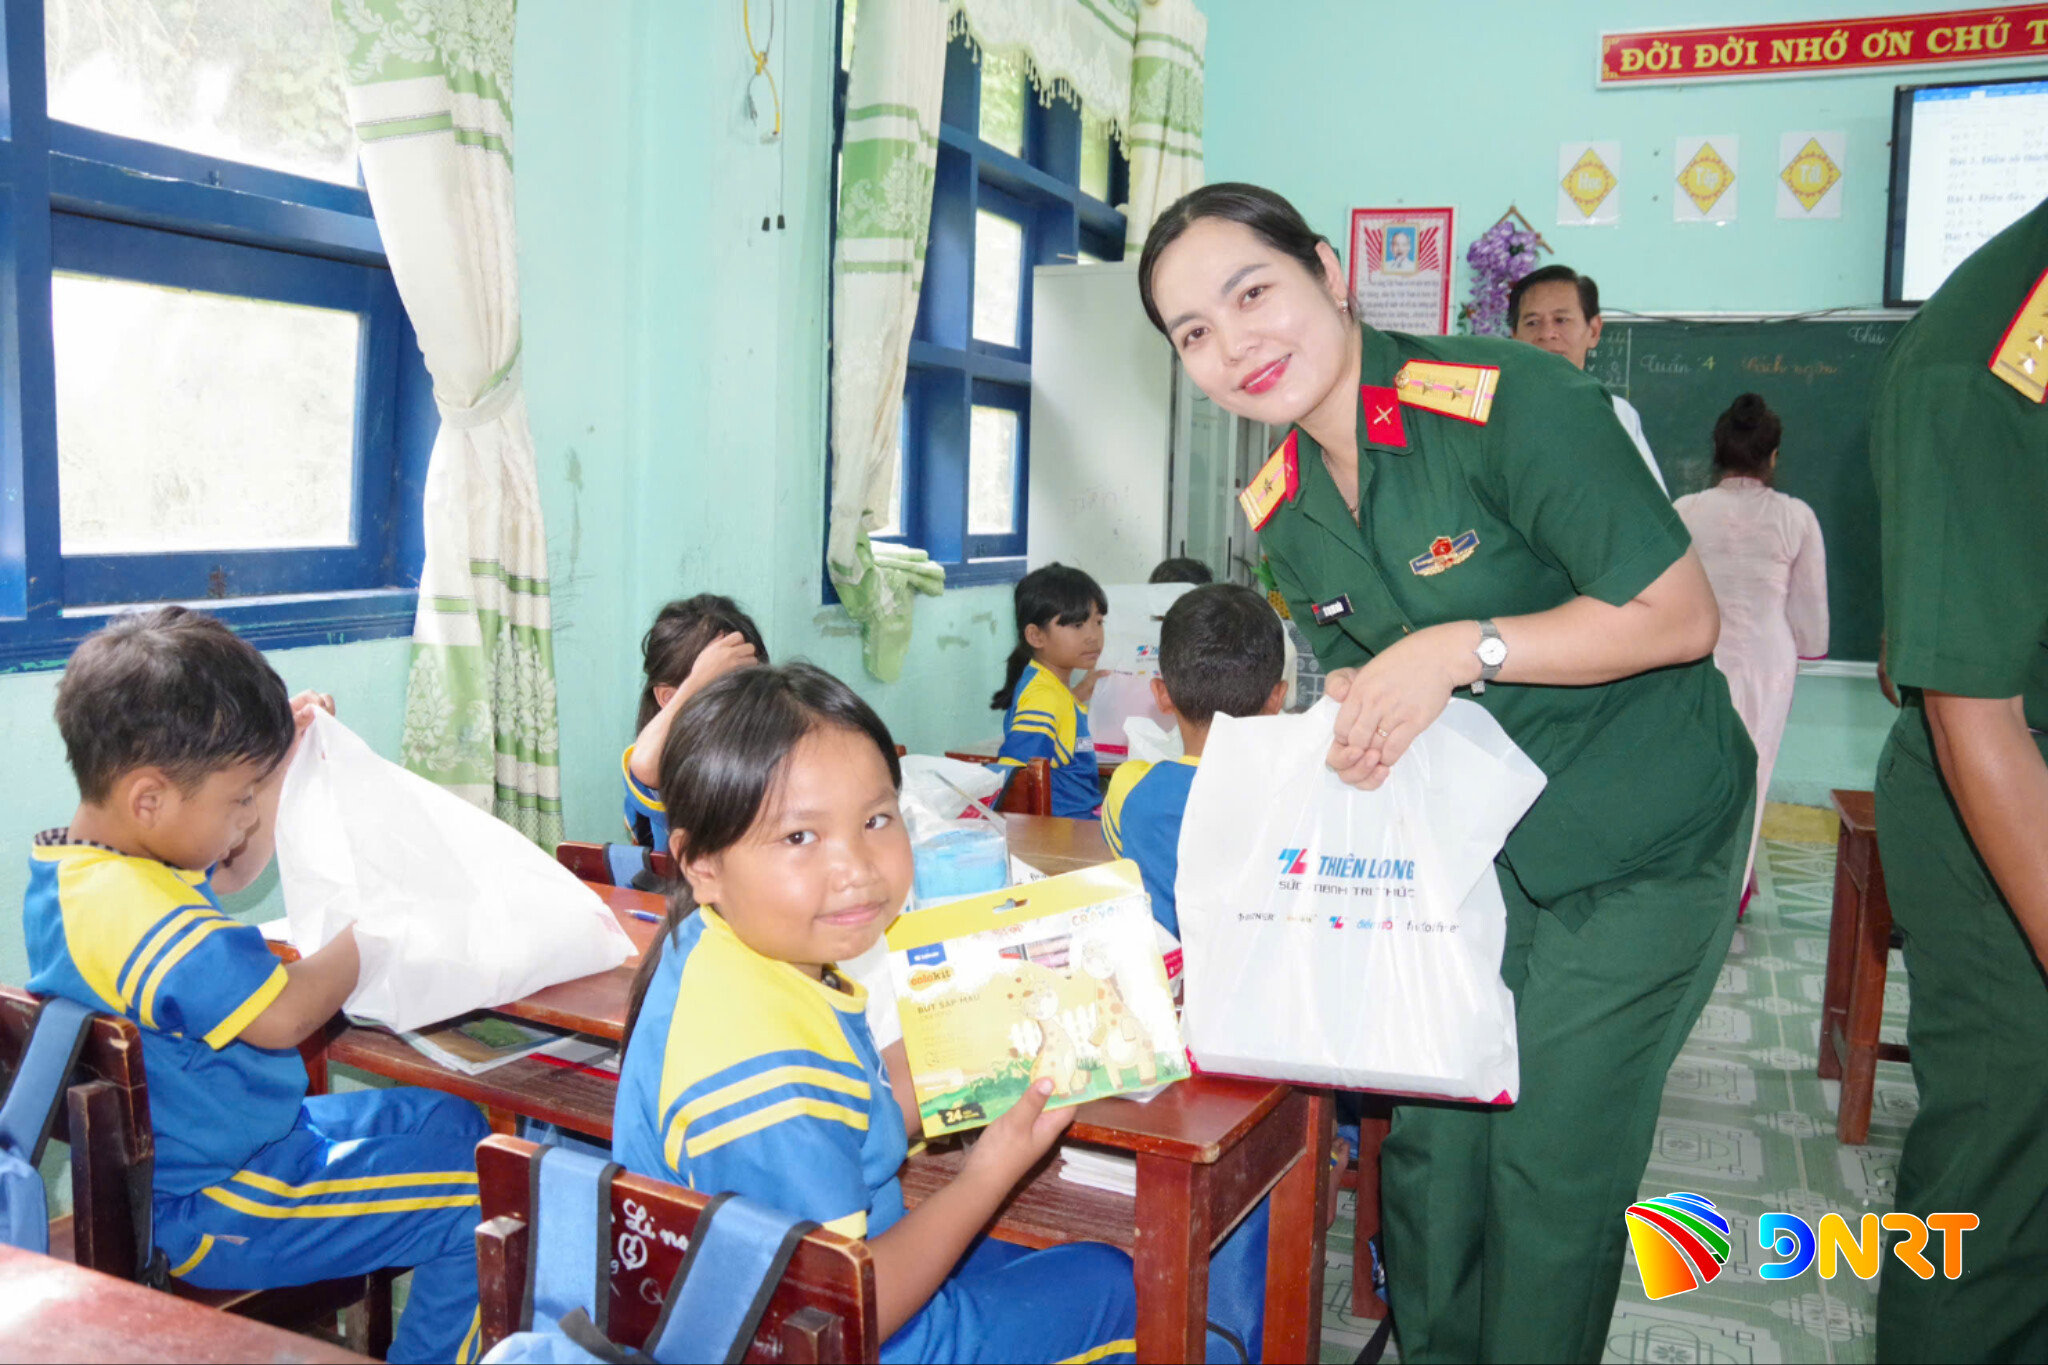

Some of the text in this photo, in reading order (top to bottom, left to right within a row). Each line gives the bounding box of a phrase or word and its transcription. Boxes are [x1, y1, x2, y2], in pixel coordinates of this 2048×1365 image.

[1619, 41, 1683, 73] ĐỜI
[1694, 35, 1759, 70] ĐỜI
[1770, 30, 1850, 64] NHỚ
[1861, 30, 1914, 58] ƠN
[1926, 16, 2012, 54] CHỦ
[1702, 355, 1716, 371] 4
[1317, 853, 1416, 881] THIÊN LONG
[910, 968, 952, 986] colokit
[945, 1108, 963, 1124] 24
